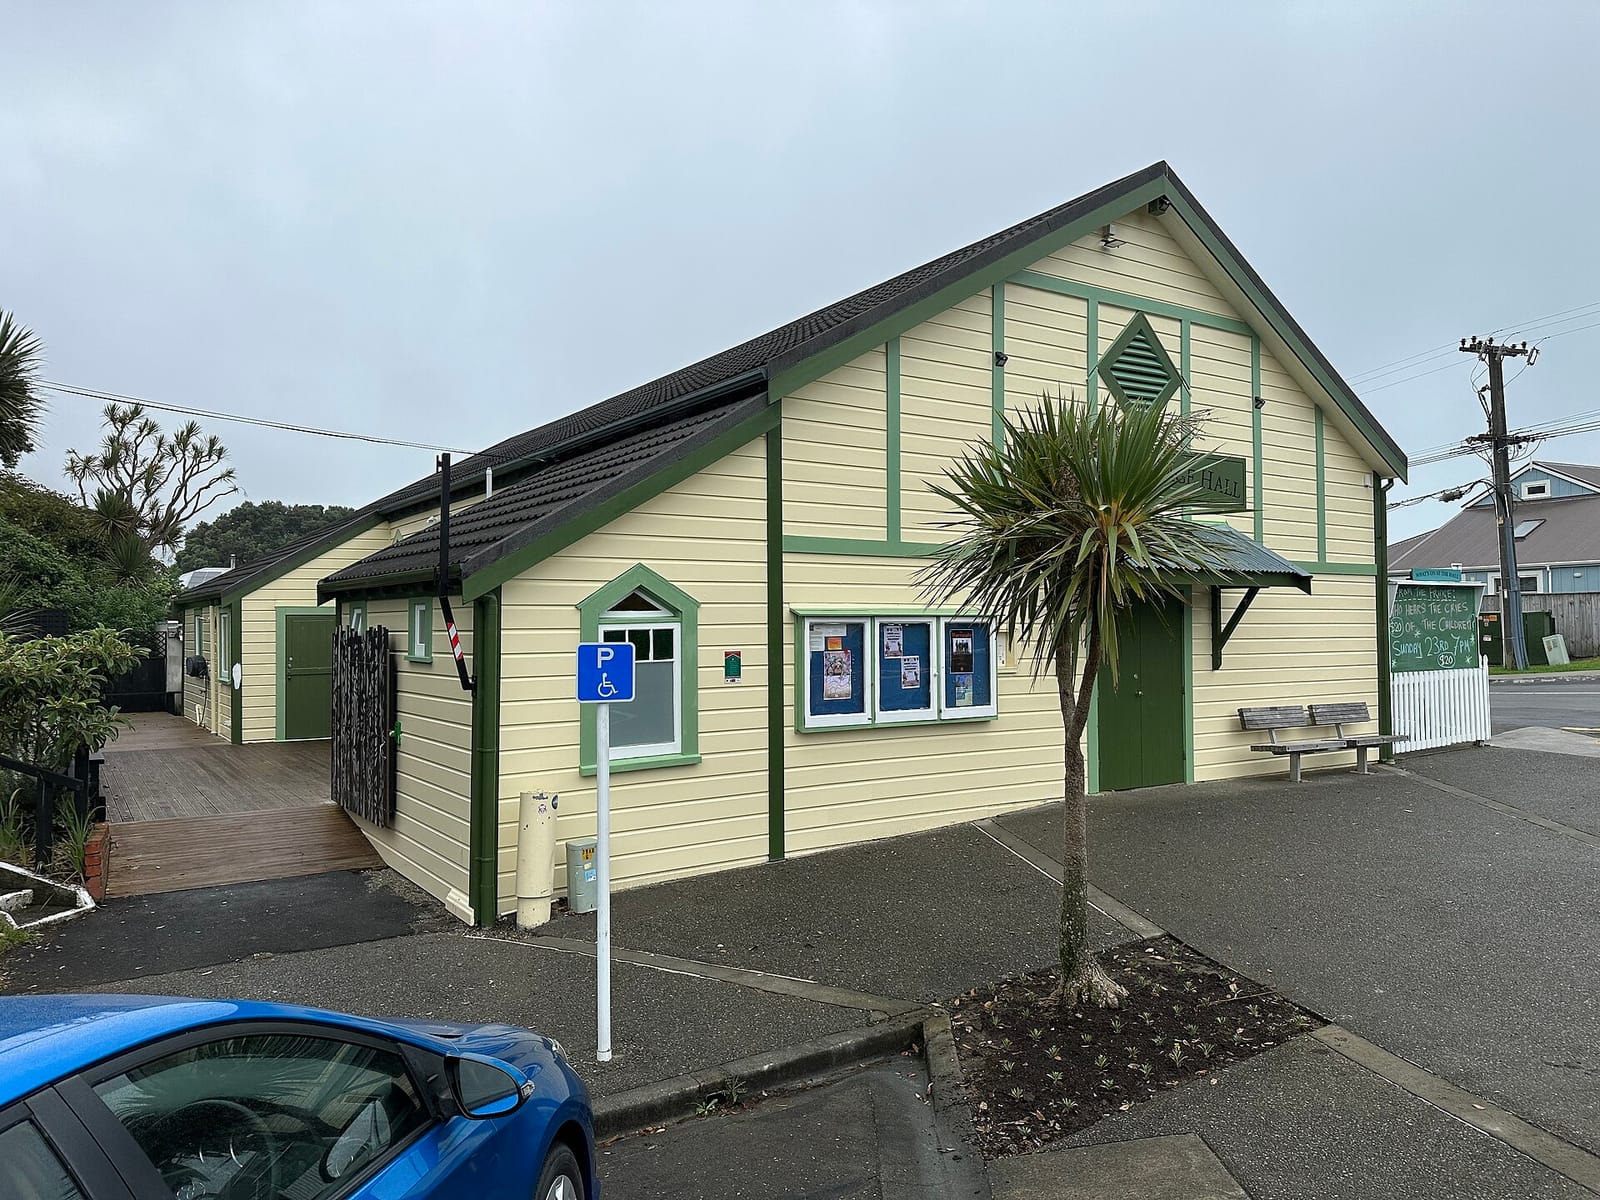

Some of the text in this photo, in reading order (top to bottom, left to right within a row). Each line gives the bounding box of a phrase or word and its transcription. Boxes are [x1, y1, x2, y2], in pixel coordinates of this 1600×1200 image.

[1201, 469, 1240, 499] HALL
[1428, 601, 1441, 614] THE
[1444, 601, 1469, 617] CRIES
[1422, 619, 1436, 631] THE
[1424, 636, 1449, 656] 23RD
[1450, 633, 1471, 656] 7PM
[597, 647, 615, 669] P
[1440, 653, 1453, 666] $20
